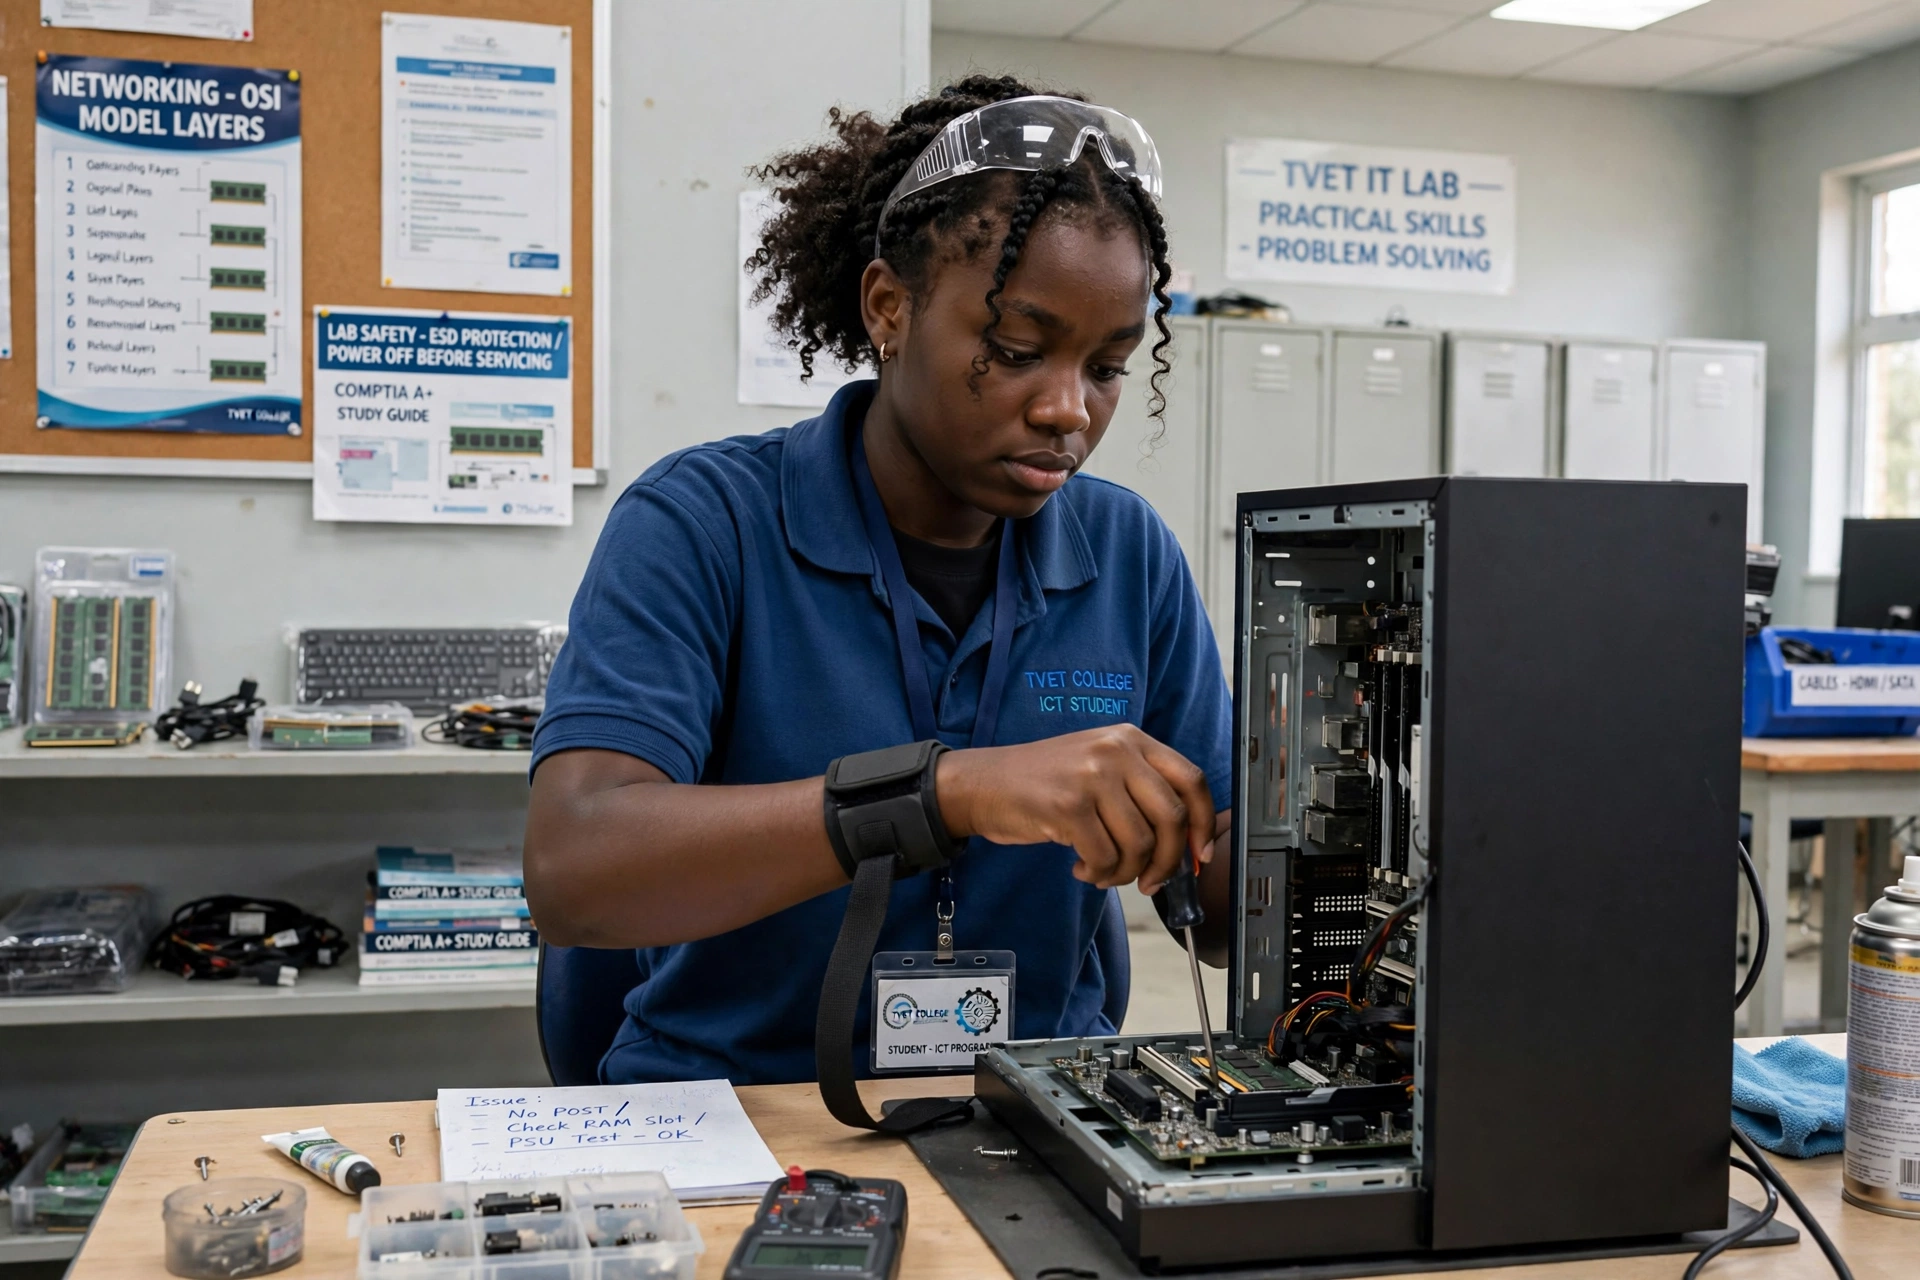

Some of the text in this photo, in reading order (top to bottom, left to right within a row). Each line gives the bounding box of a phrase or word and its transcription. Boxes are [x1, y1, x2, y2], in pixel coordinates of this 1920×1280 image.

[52, 69, 220, 106] NETWORKING
[240, 82, 281, 111] OSI
[79, 104, 266, 142] MODEL LAYERS
[67, 156, 73, 170] 1
[66, 180, 75, 193] 2
[1282, 160, 1460, 200] TVET IT LAB
[1259, 201, 1486, 238] PRACTICAL SKILLS
[66, 224, 75, 238] 3
[1258, 236, 1378, 266] PROBLEM
[1386, 243, 1492, 273] SOLVING
[66, 269, 76, 282] 4
[66, 292, 75, 306] 5
[66, 314, 76, 329] 6
[66, 338, 76, 351] 6
[328, 323, 357, 341] LAB
[361, 325, 417, 344] SAFETY
[429, 327, 458, 345] ESD
[461, 328, 552, 349] PROTECTION
[328, 345, 552, 370] POWER OFF BEFORE SERVICING
[67, 361, 76, 374] 7
[335, 383, 433, 400] COMPTIA A+
[338, 407, 430, 422] STUDY GUIDE
[1025, 670, 1132, 690] TVET COLLEGE
[1040, 696, 1128, 715] ICT STUDENT
[388, 887, 438, 899] COMPTIA
[458, 886, 491, 898] STUDY
[375, 932, 531, 950] COMPTIA A+ STUDY GUIDE
[888, 1044, 928, 1055] STUDENT
[935, 1044, 949, 1054] ICT
[508, 1109, 537, 1118] No
[554, 1105, 609, 1117] POST
[507, 1121, 570, 1133] Check
[584, 1118, 631, 1130] RAM
[645, 1114, 686, 1126] Slot
[509, 1136, 554, 1148] PSU
[572, 1132, 622, 1143] Test
[657, 1129, 694, 1139] OK
